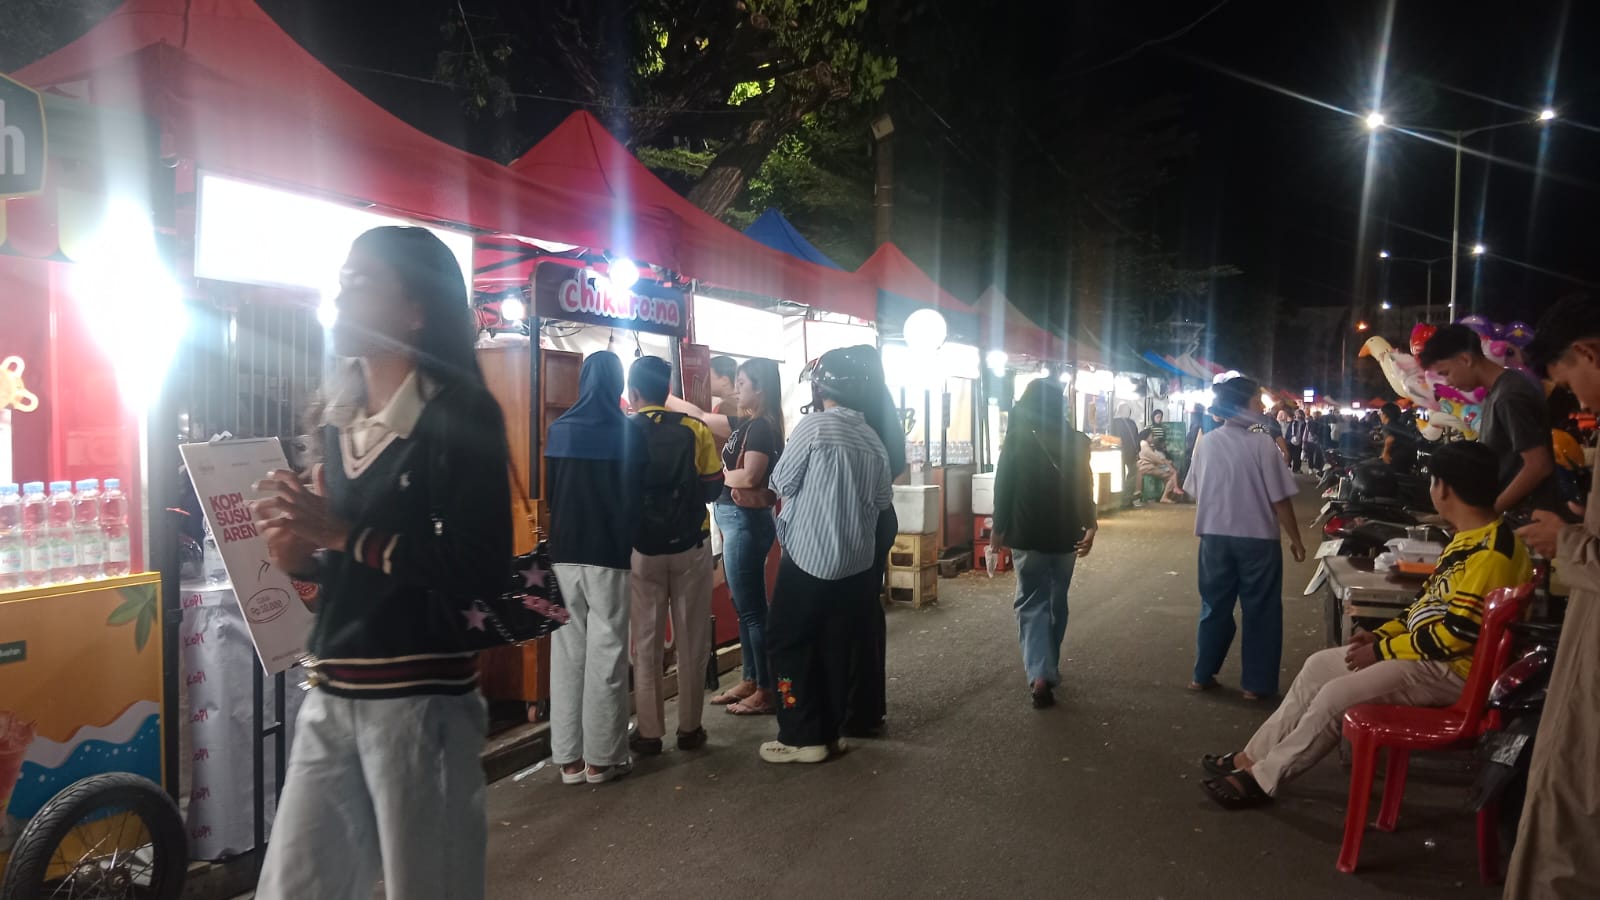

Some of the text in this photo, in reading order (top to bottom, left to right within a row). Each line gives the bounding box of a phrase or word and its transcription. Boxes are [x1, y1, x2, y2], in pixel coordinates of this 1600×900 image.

[209, 492, 244, 512] KOPI
[215, 508, 252, 527] SUSU
[223, 522, 259, 543] AREN
